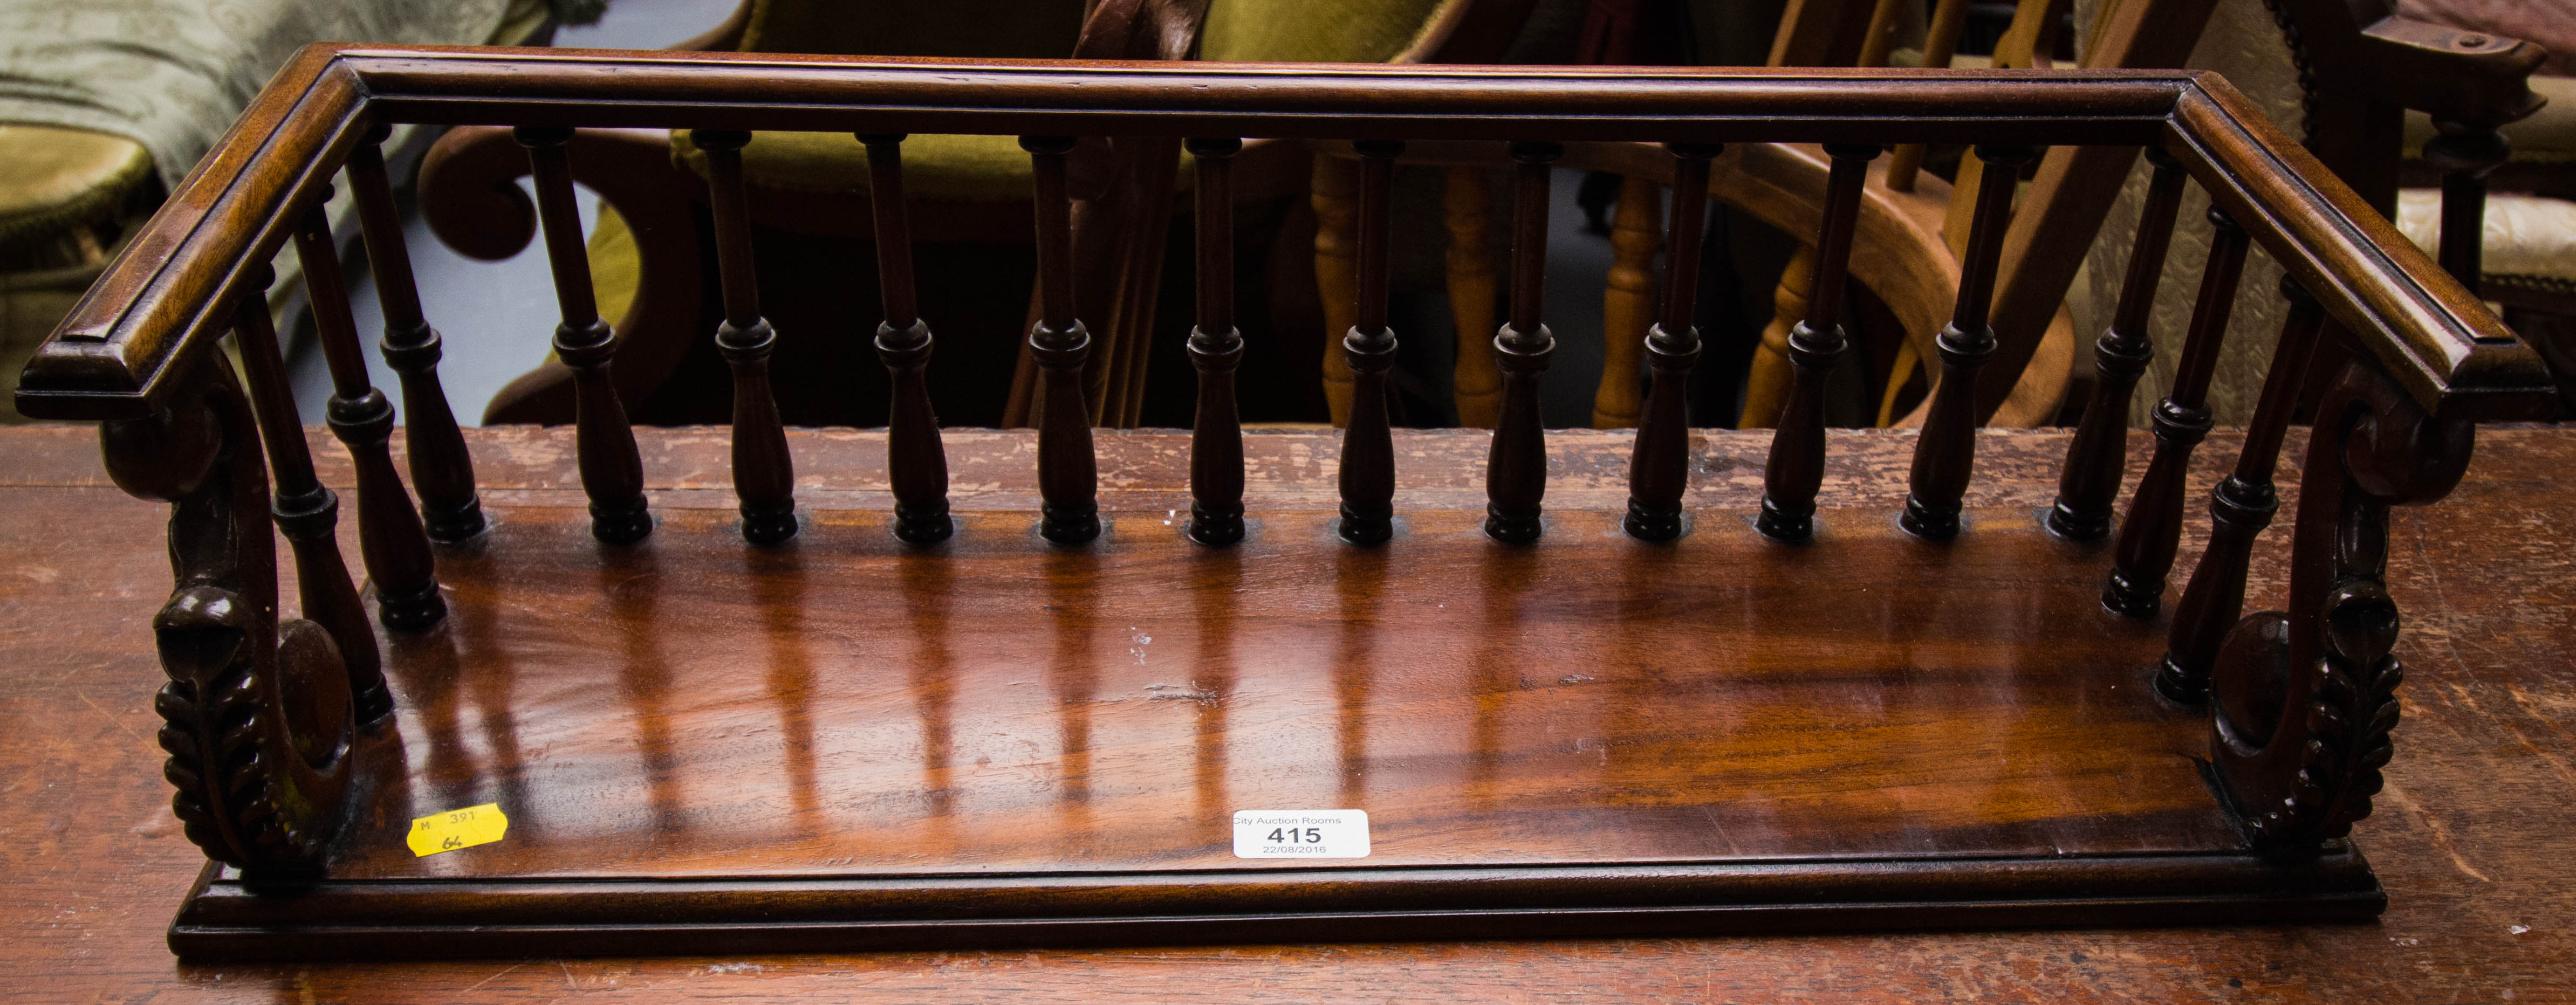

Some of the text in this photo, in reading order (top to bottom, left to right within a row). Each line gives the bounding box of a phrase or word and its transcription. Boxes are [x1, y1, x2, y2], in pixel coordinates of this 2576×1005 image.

[421, 811, 475, 830] M 391
[1234, 817, 1252, 825] City
[1268, 828, 1321, 843] 415
